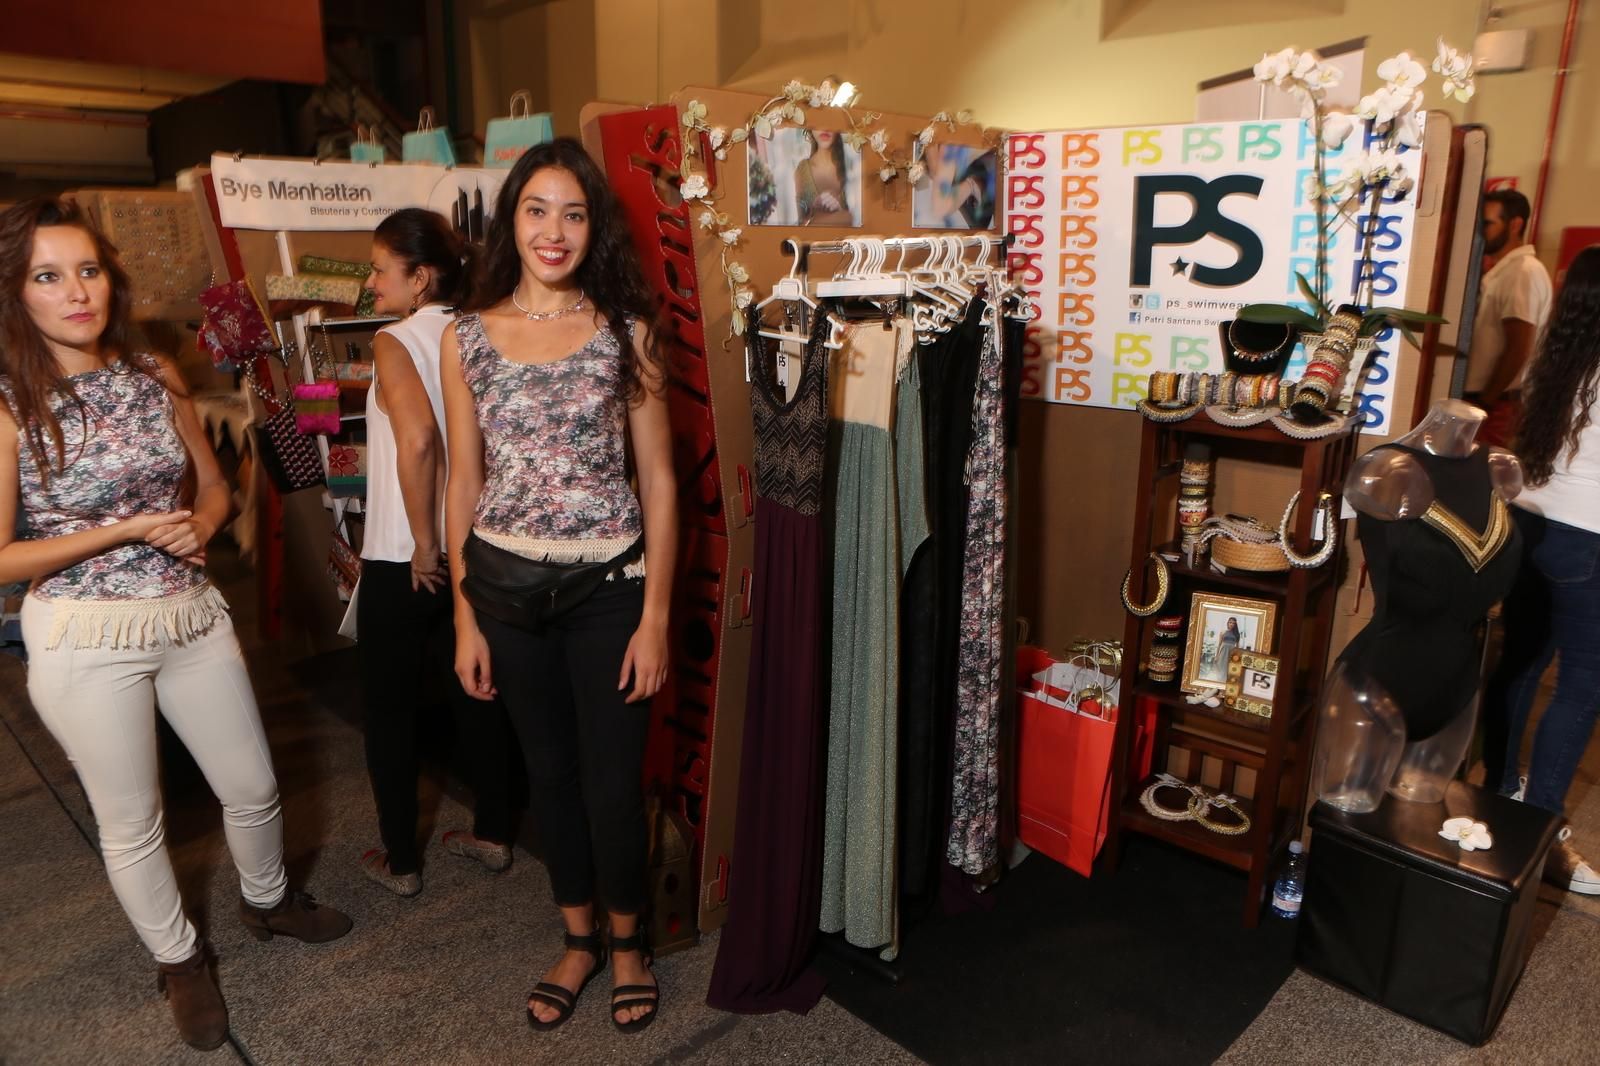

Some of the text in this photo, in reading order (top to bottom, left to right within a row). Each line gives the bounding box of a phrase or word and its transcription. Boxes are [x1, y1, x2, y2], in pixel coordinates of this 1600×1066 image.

[1008, 134, 1046, 171] PS
[1061, 133, 1100, 170] PS
[1121, 129, 1163, 167] PS
[1181, 126, 1224, 164] PS
[1237, 123, 1282, 162] PS
[220, 177, 373, 202] Bye Manhattan
[1008, 175, 1045, 211] PS
[1061, 175, 1099, 211] PS
[310, 206, 350, 216] Bisuteria
[353, 208, 359, 217] y
[1007, 214, 1044, 249] PS
[1060, 214, 1098, 249] PS
[1129, 174, 1264, 290] PS
[1058, 253, 1096, 288] PS
[1057, 292, 1095, 326] PS
[1144, 315, 1164, 324] Patri
[1166, 316, 1201, 326] Santana
[1056, 330, 1094, 364] PS
[1113, 332, 1152, 368] PS
[1169, 335, 1210, 371] PS
[1054, 367, 1092, 402] PS
[1111, 372, 1149, 407] PS
